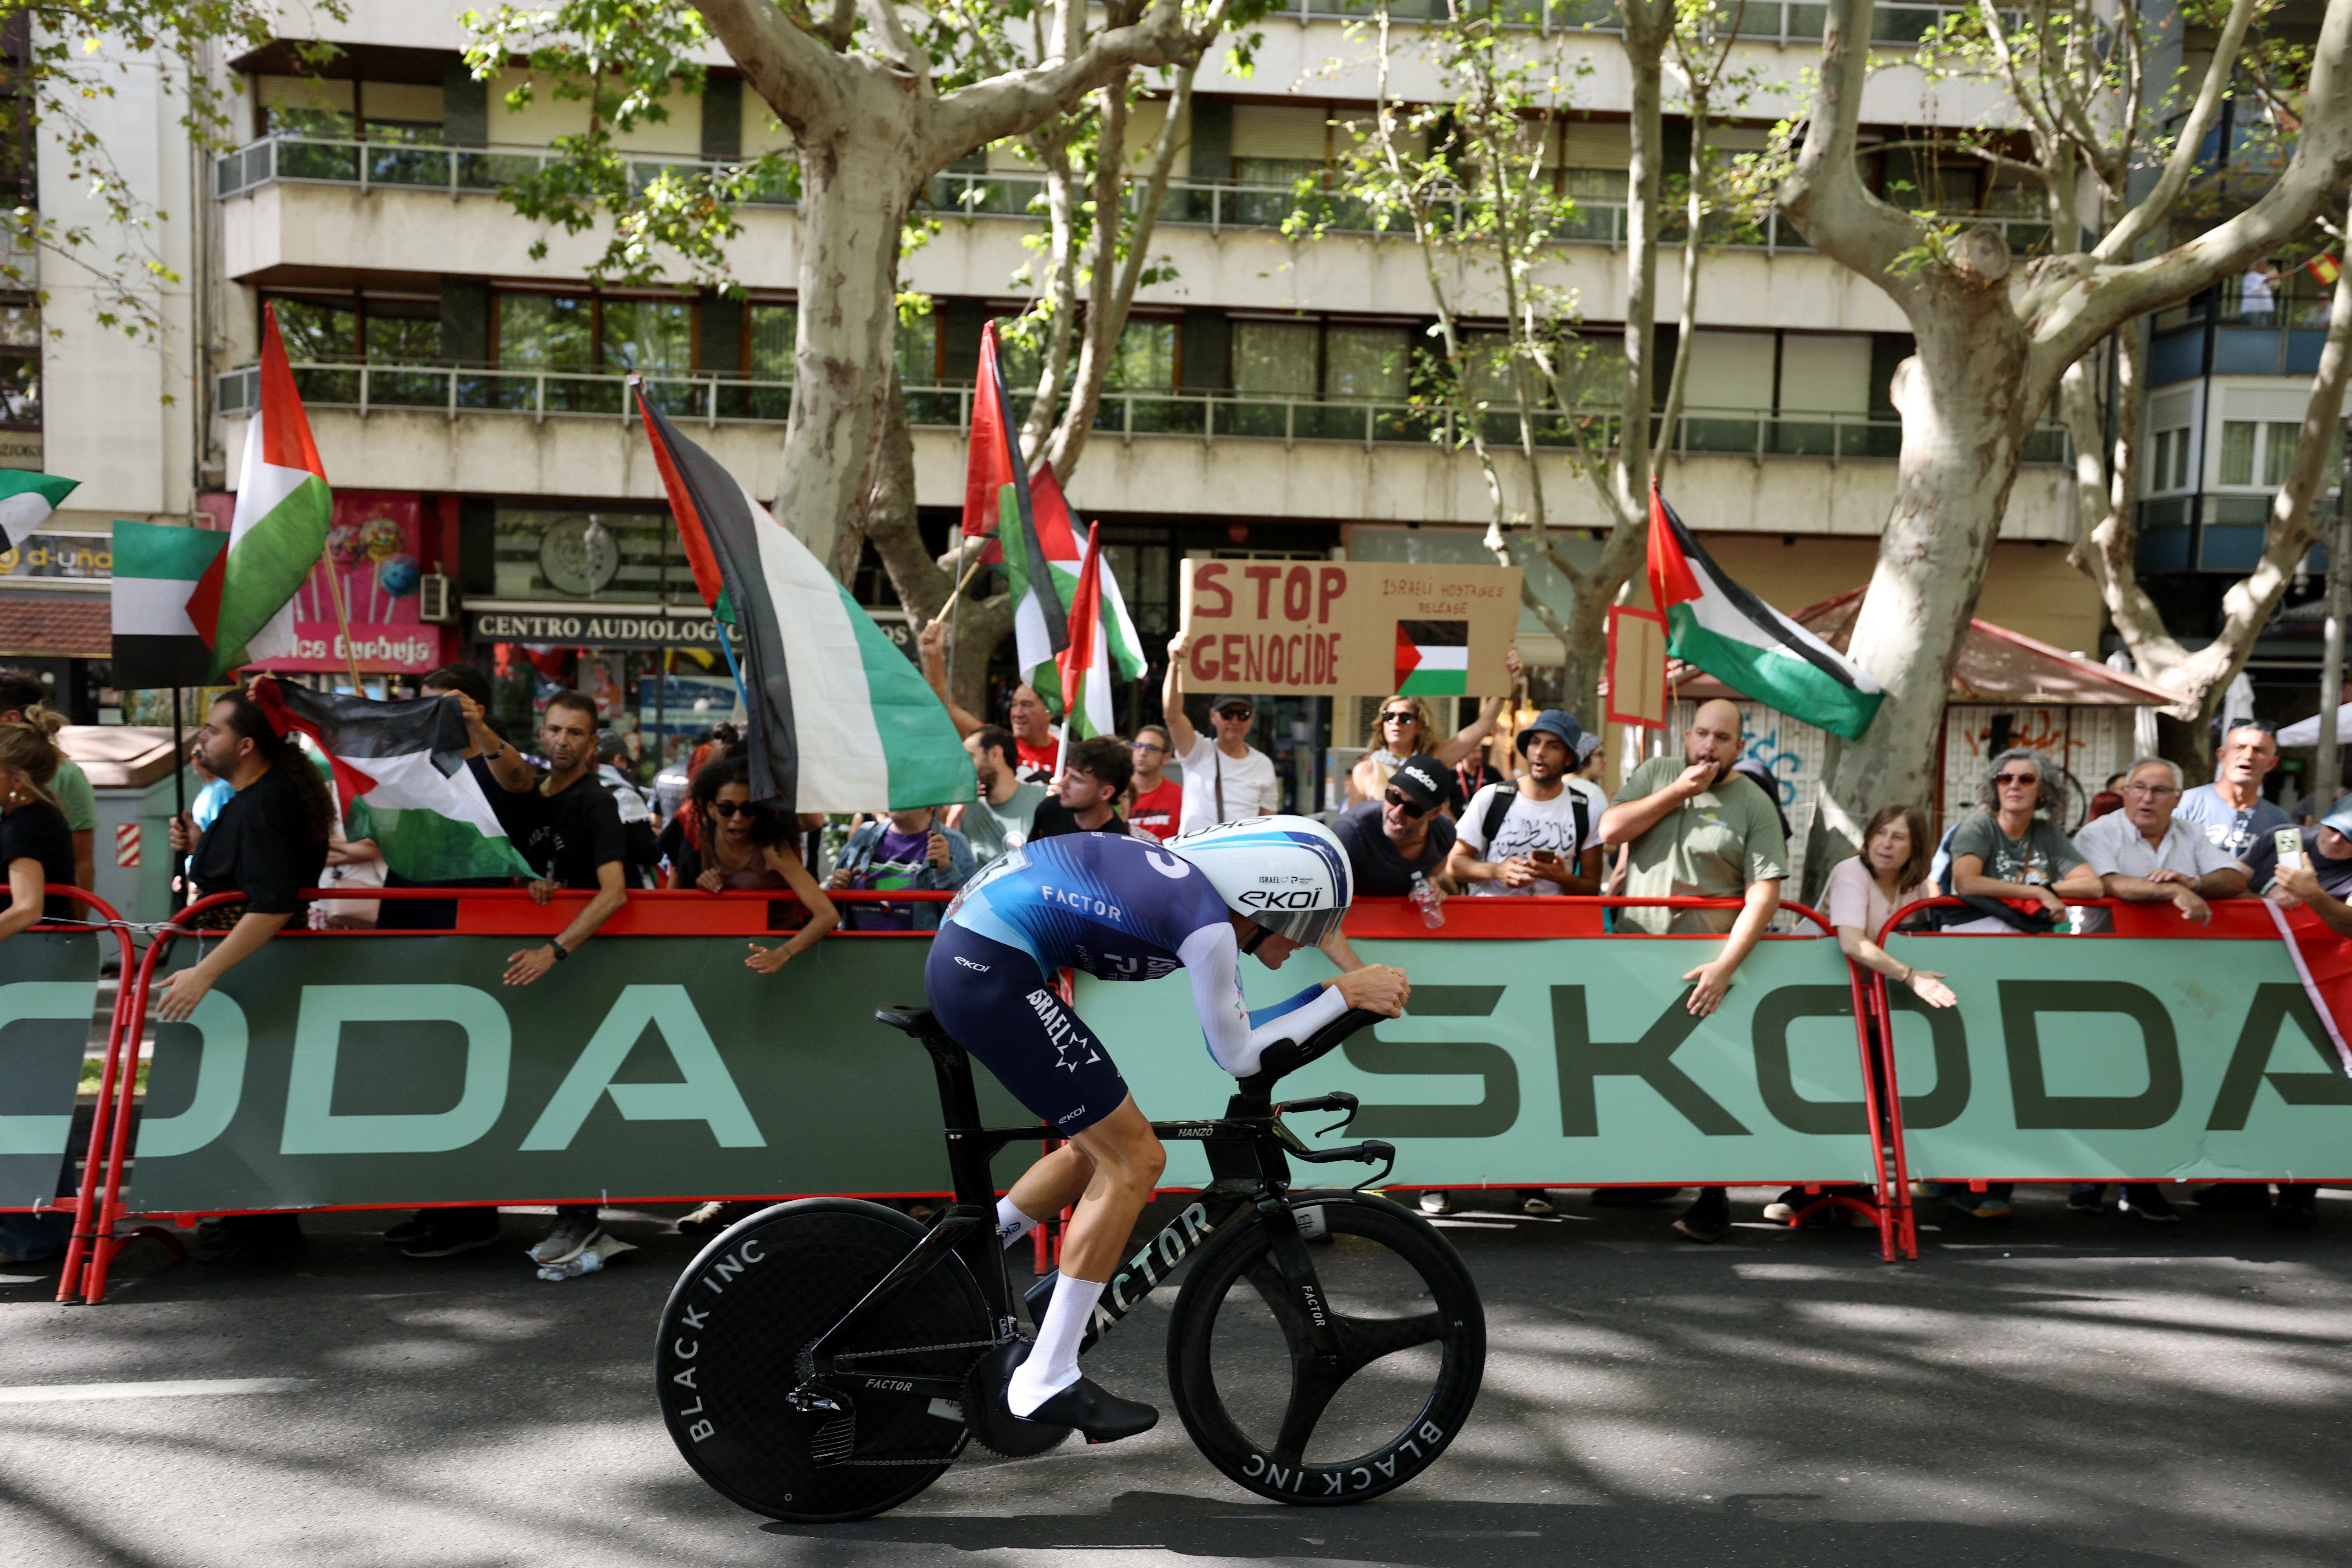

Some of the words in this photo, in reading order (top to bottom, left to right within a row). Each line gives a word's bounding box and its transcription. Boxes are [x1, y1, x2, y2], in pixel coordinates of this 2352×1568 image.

[1194, 563, 1347, 624] STOP
[478, 616, 581, 638] CENTRO
[1042, 885, 1121, 923] FACTOR
[1025, 989, 1071, 1046] ISRAEL
[1083, 1202, 1215, 1340] ACTOR
[1302, 1285, 1326, 1327] FACTOR
[674, 1304, 715, 1443] BLACK
[703, 1240, 766, 1294] INC
[865, 1378, 913, 1391] FACTOR
[1243, 1454, 1304, 1492] INC
[1323, 1420, 1443, 1495] BLACK
